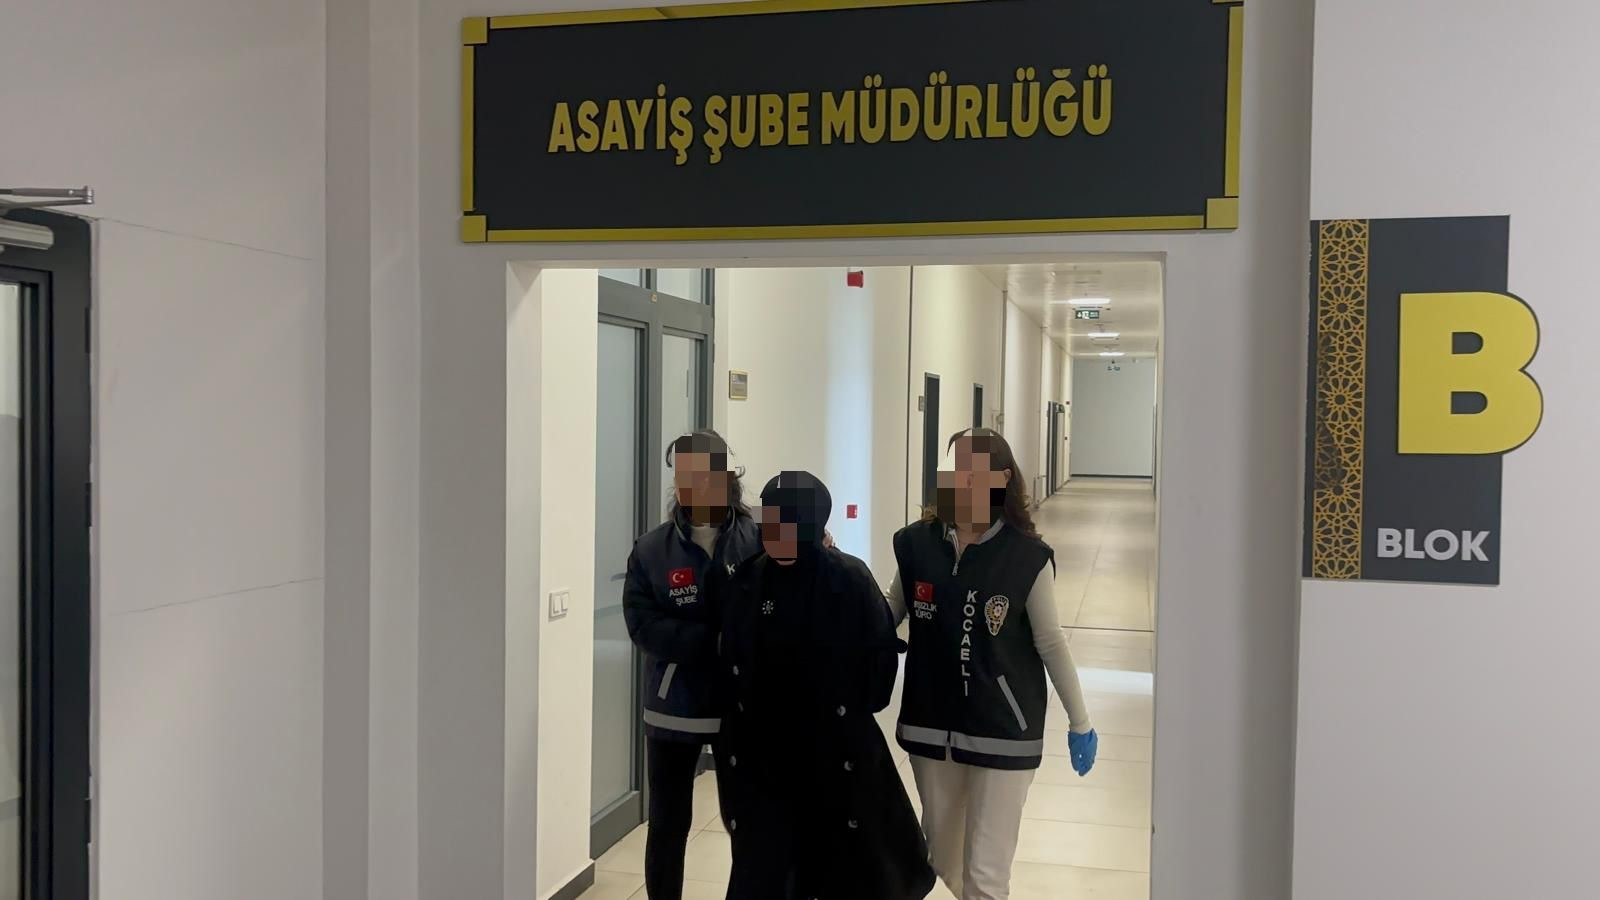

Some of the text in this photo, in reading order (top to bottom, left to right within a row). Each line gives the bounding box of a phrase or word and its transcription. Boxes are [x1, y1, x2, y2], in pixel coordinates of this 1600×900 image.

[547, 64, 1113, 165] ASAYİŞ ŞUBE MÜDÜRLÜĞÜ
[1398, 291, 1543, 455] B
[1377, 528, 1490, 562] BLOK
[669, 584, 698, 598] ASAYİŞ
[675, 595, 697, 607] ŞUBE
